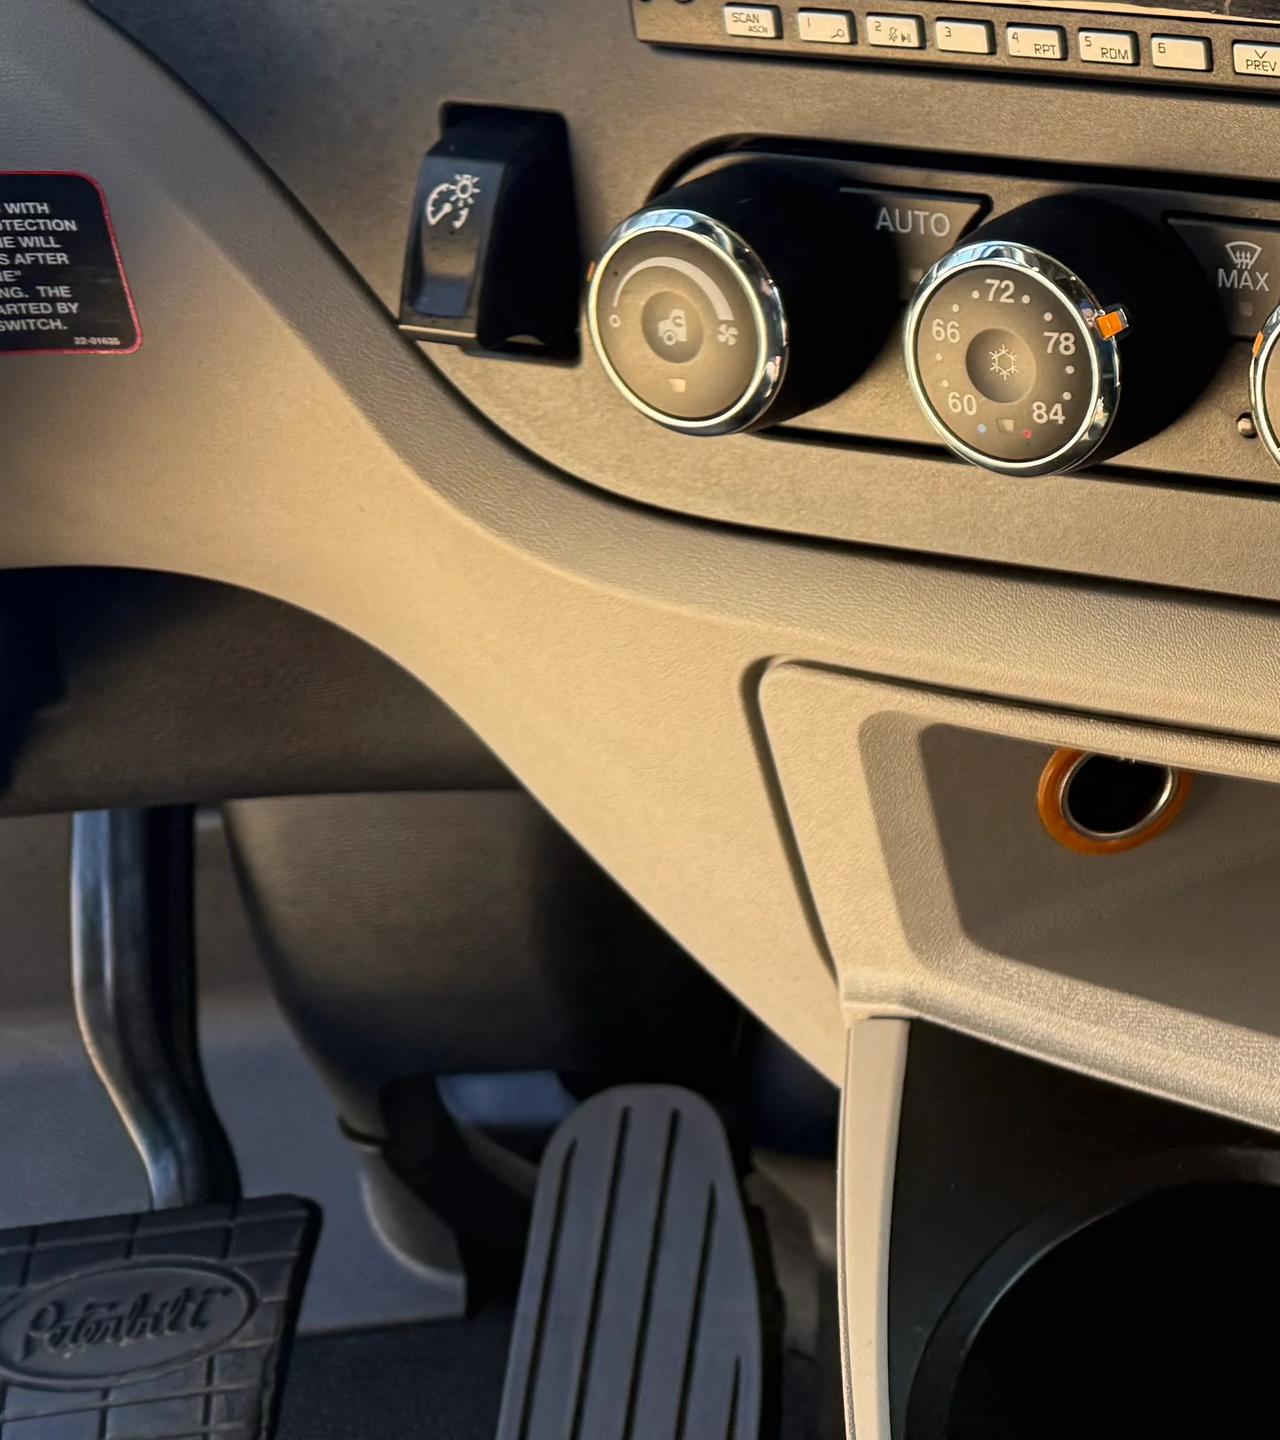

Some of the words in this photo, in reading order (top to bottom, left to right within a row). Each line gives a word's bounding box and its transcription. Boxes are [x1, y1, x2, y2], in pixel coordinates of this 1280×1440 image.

[732, 12, 760, 24] SCAN
[874, 20, 882, 32] 2
[944, 26, 952, 38] 3
[1011, 32, 1019, 43] 4
[1084, 36, 1093, 47] 5
[1034, 43, 1057, 56] RPT
[1101, 47, 1129, 60] RDM
[1157, 42, 1167, 54] 6
[1246, 59, 1277, 73] PREV
[4, 202, 50, 214] WITH
[876, 206, 951, 238] AUTO
[18, 236, 62, 248] WILL
[15, 252, 70, 265] AFTER
[1217, 267, 1270, 293] MAX
[36, 285, 72, 297] THE
[984, 278, 1015, 304] 72
[57, 302, 79, 314] BY
[931, 318, 961, 343] 66
[1042, 332, 1076, 356] 78
[947, 392, 978, 417] 60
[1031, 402, 1066, 426] 84
[17, 1287, 234, 1361] Peterbilt
